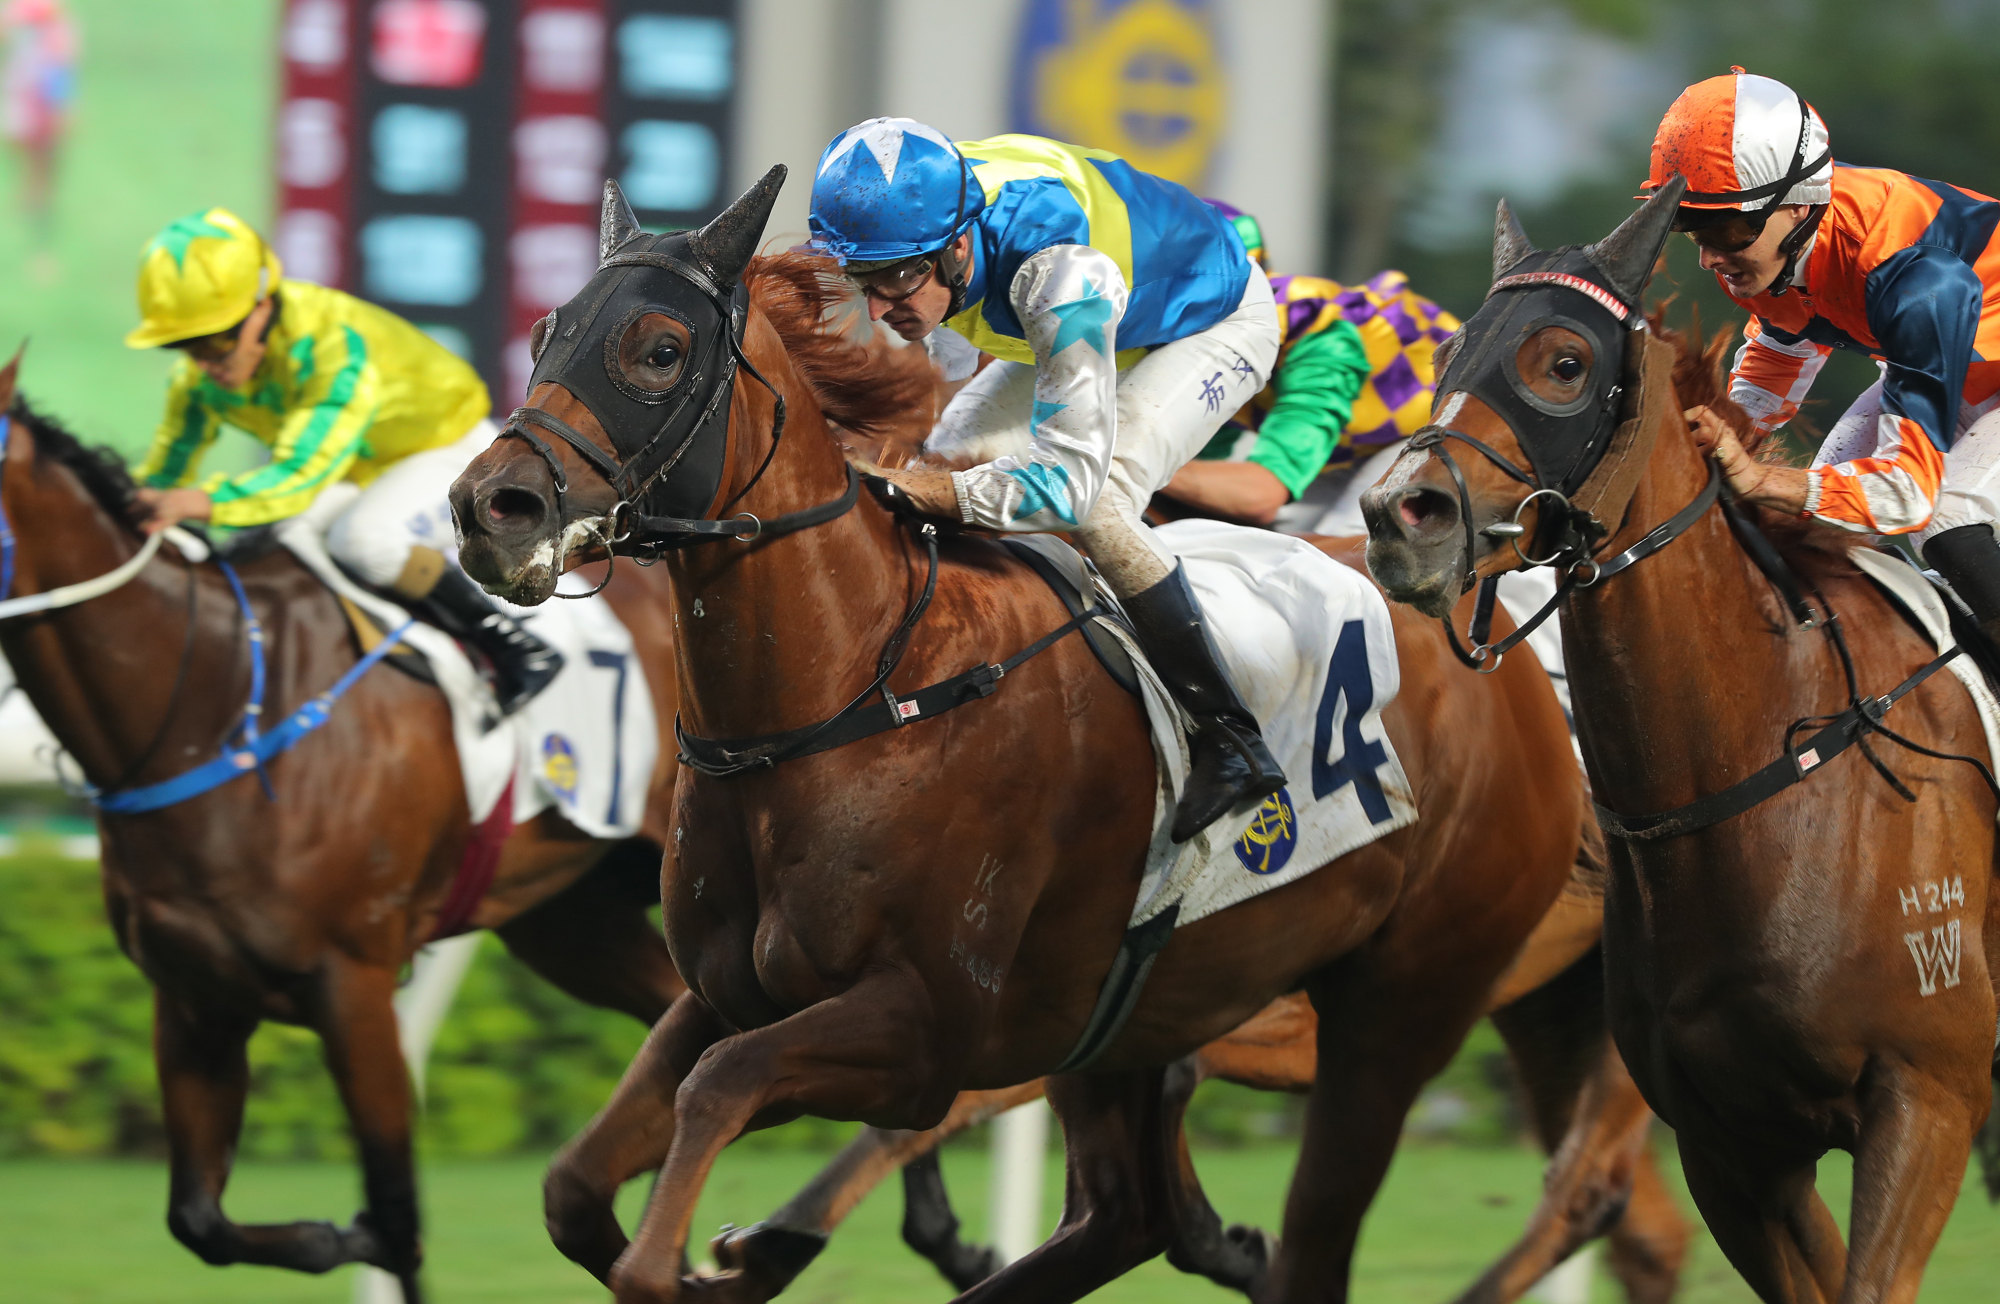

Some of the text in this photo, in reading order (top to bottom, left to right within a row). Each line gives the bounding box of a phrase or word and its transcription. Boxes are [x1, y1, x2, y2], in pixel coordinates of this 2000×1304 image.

[587, 650, 627, 824] 7
[1312, 619, 1394, 826] 4
[1904, 919, 1961, 997] W
